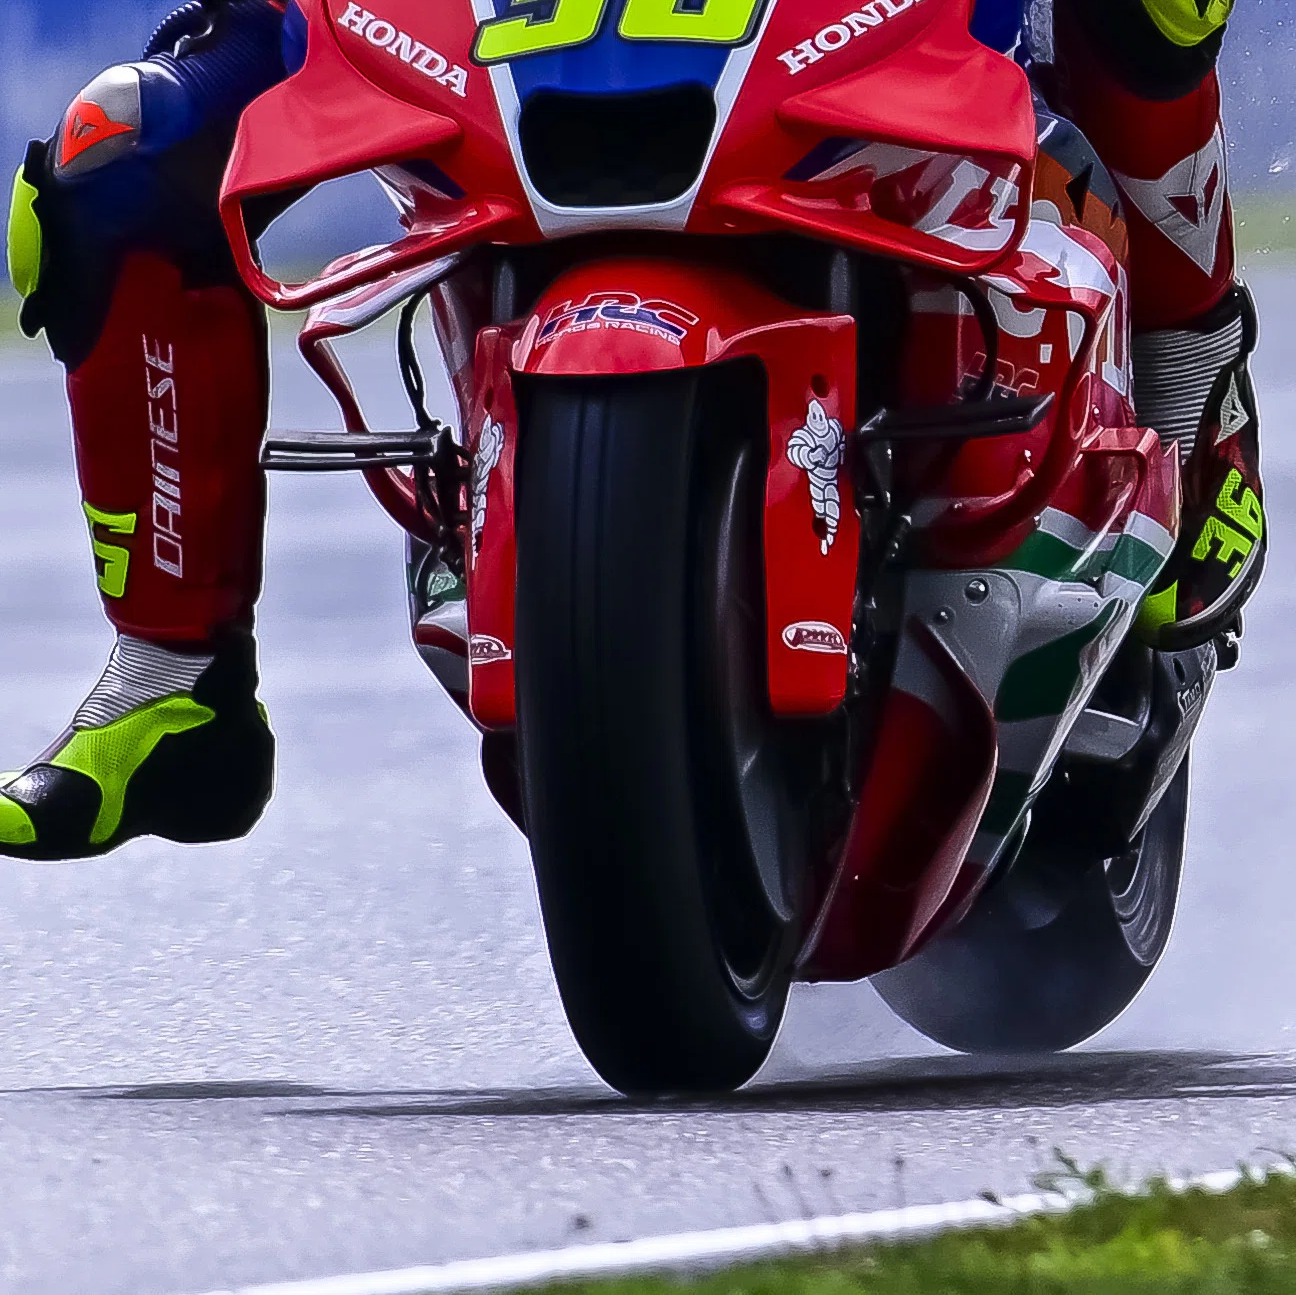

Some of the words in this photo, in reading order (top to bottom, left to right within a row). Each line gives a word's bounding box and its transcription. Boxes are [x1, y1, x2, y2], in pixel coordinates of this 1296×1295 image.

[338, 1, 469, 98] HONDA
[538, 291, 700, 342] HRC
[605, 321, 681, 346] RACING
[142, 333, 183, 579] DAINESE
[1192, 468, 1263, 579] 36
